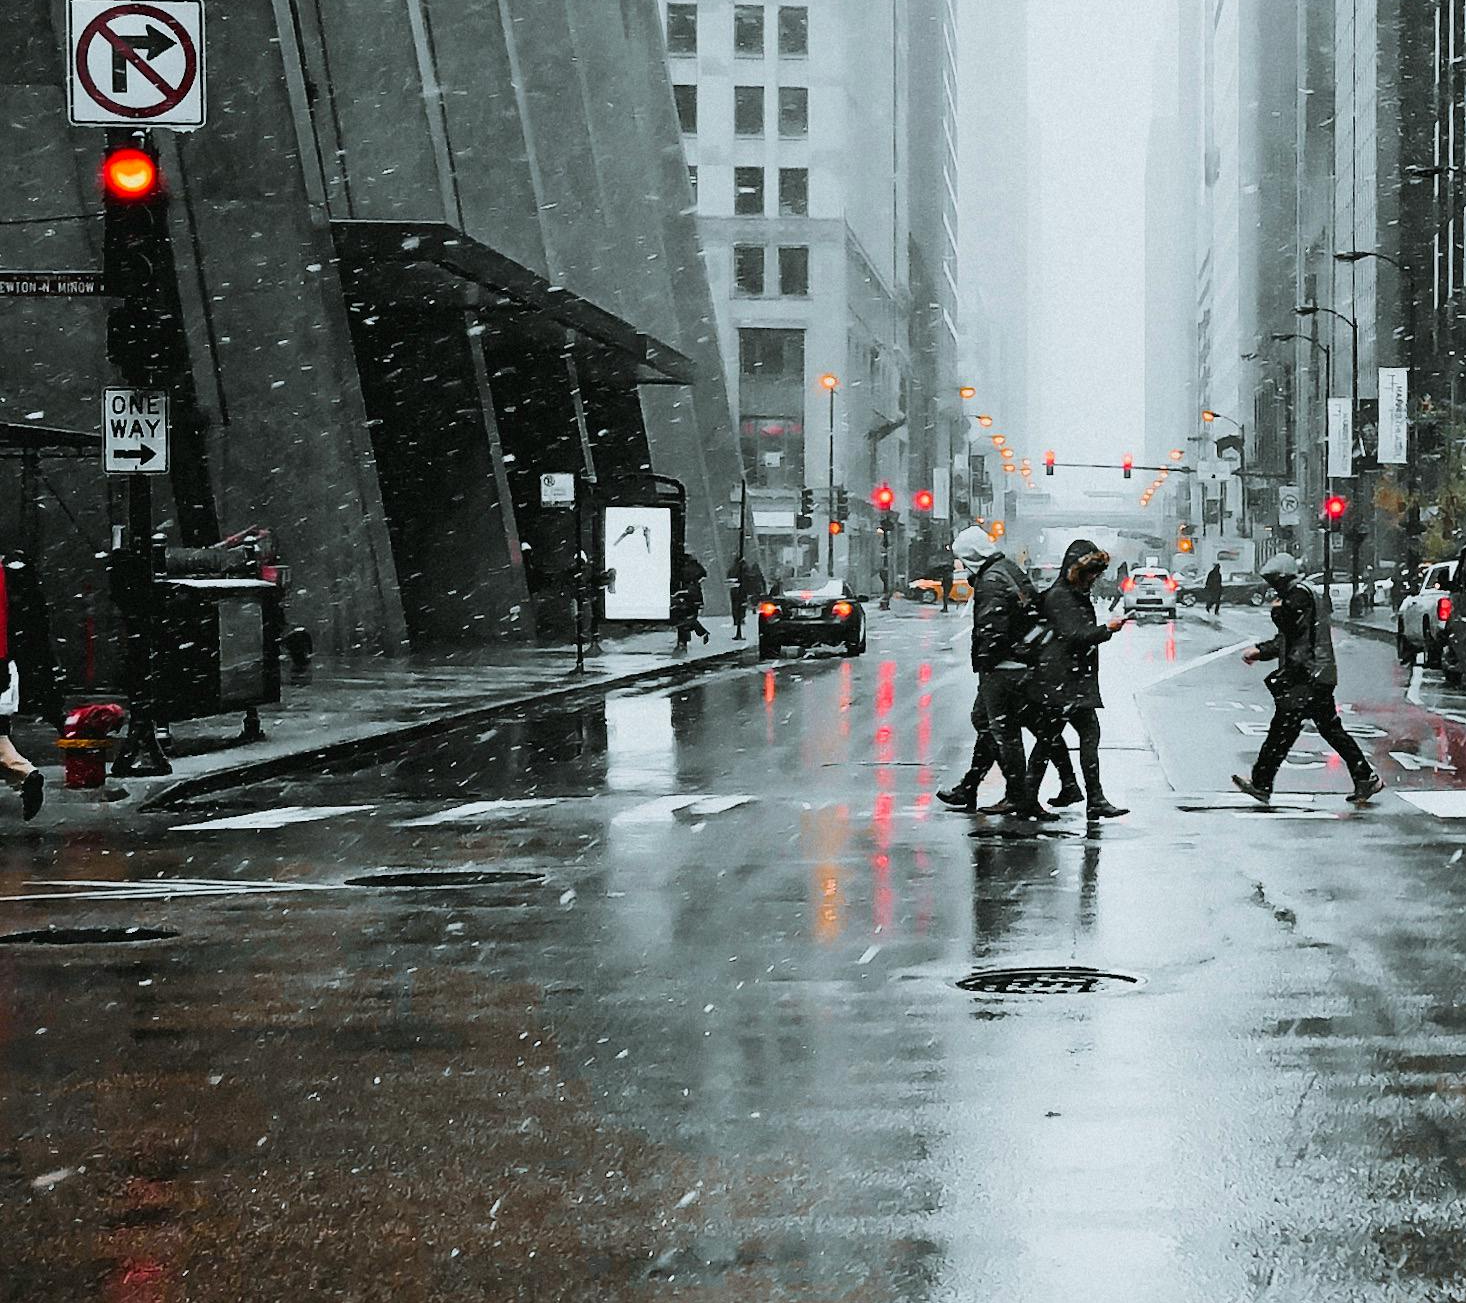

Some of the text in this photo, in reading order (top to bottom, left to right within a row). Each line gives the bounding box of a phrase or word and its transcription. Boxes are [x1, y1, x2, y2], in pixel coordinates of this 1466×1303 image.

[58, 281, 94, 294] MINOW
[112, 395, 160, 414] ONE
[111, 419, 161, 438] WAY
